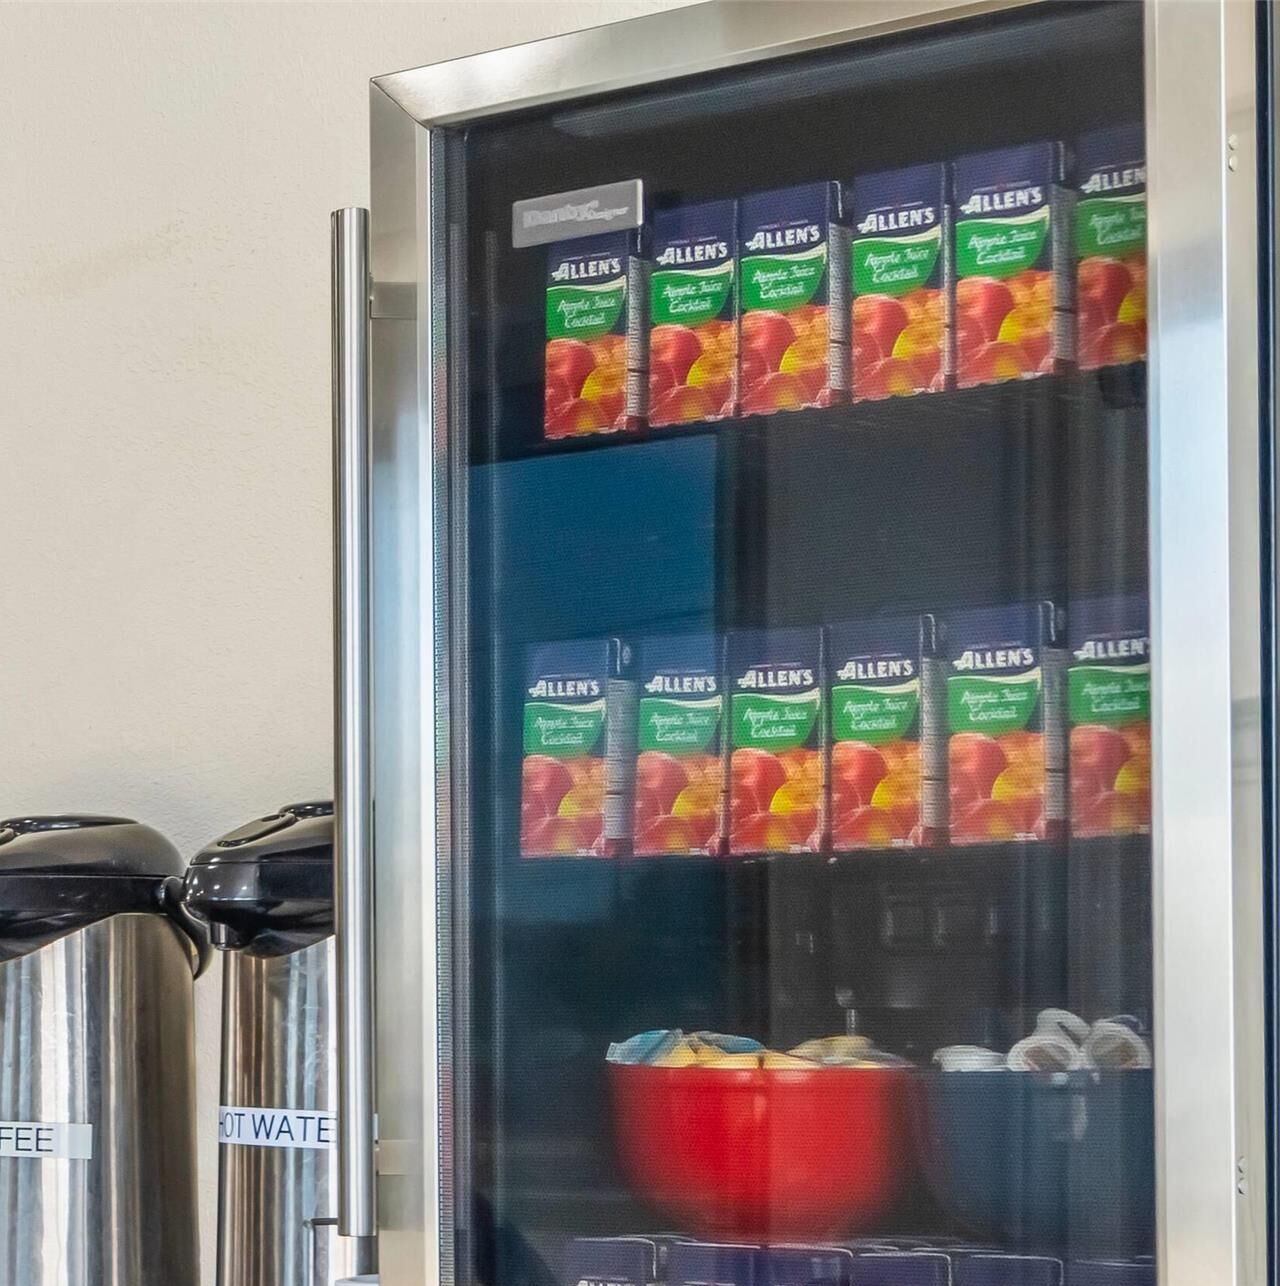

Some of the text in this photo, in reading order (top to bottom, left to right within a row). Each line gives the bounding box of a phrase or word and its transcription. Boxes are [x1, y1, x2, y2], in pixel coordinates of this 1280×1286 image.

[1080, 168, 1146, 193] ALLEN
[960, 187, 1042, 214] ALLEN'S
[857, 208, 935, 233] ALLEN'S
[745, 225, 820, 250] ALLEN'S
[656, 242, 728, 265] ALLEN'S
[552, 258, 621, 281] ALLEN'S
[952, 648, 1034, 670] ALLEN'S
[1073, 637, 1149, 660] ALLEN'
[737, 669, 813, 688] ALLEN'S
[836, 660, 913, 680] ALLEN'S
[528, 680, 599, 697] ALLEN'S
[645, 676, 716, 693] ALLEN'S
[252, 1114, 337, 1142] WATE
